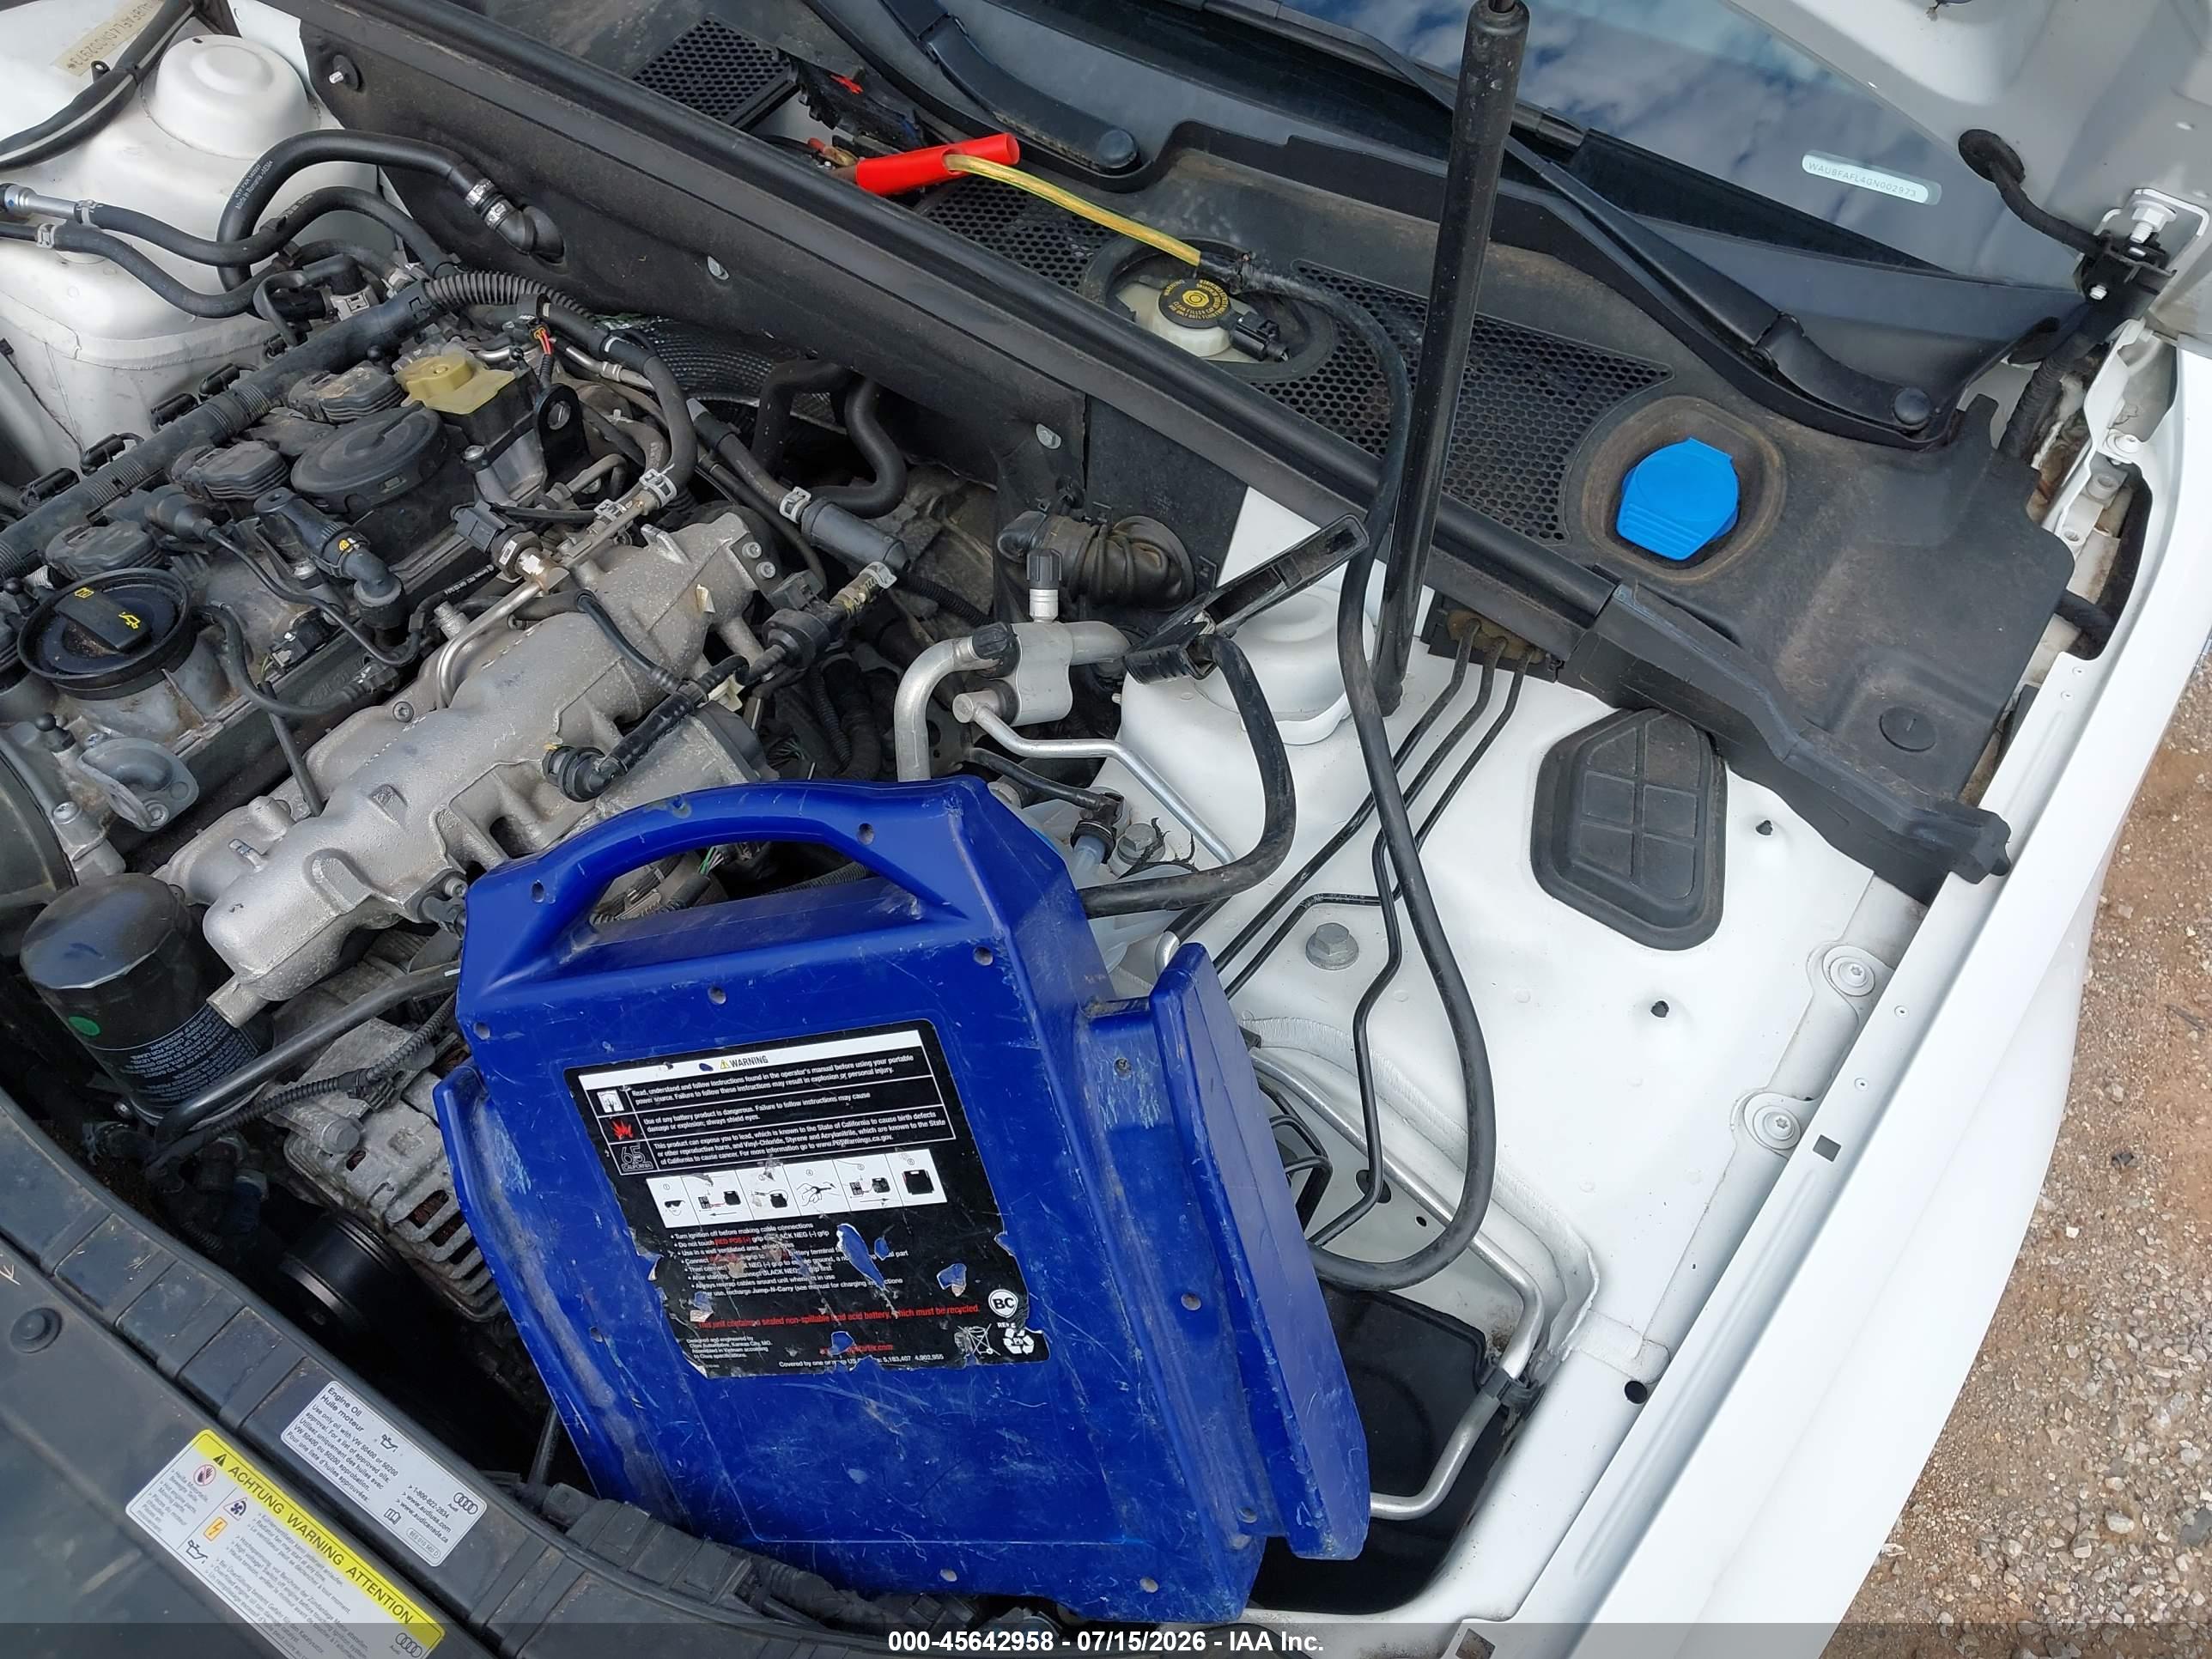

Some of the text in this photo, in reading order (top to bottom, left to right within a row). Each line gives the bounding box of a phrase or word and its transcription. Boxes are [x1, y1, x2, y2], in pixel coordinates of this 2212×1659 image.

[630, 1089, 649, 1098] Read,
[647, 1085, 681, 1095] understand
[690, 1080, 711, 1089] follow
[708, 1076, 744, 1087] instructions
[742, 1073, 763, 1083] found
[810, 1064, 834, 1074] manual
[833, 1061, 854, 1071] before
[854, 1059, 873, 1069] using
[872, 1059, 889, 1067] your
[886, 1054, 915, 1065] portable
[728, 1054, 769, 1068] WARNING
[635, 1097, 653, 1106] power
[673, 1091, 695, 1100] Failure
[700, 1088, 720, 1097] follow
[719, 1085, 738, 1094] these
[735, 1081, 772, 1091] instructions
[784, 1077, 804, 1086] result
[809, 1073, 840, 1084] explosion
[846, 1067, 875, 1079] personal
[873, 1065, 895, 1076] injury.
[646, 1124, 671, 1133] damage
[704, 1117, 727, 1127] always
[725, 1115, 744, 1123] shield
[744, 1114, 761, 1122] eyes.
[672, 1113, 695, 1123] battery
[692, 1109, 717, 1121] product
[754, 1103, 776, 1111] Failure
[782, 1099, 802, 1108] follow
[801, 1095, 838, 1106] instructions
[665, 1139, 690, 1150] product
[699, 1137, 721, 1146] expose
[738, 1132, 755, 1141] lead,
[752, 1129, 771, 1138] which
[777, 1127, 799, 1135] known
[816, 1122, 834, 1131] State
[840, 1118, 871, 1128] California
[896, 1113, 913, 1121] birth
[911, 1110, 937, 1120] defects
[665, 1155, 695, 1164] California
[764, 1144, 799, 1153] information
[992, 1297, 1017, 1310] BC
[319, 1394, 365, 1432] Huile moteur
[325, 1386, 363, 1417] Engine Oil
[310, 1403, 324, 1415] Use
[320, 1412, 335, 1425] only
[331, 1420, 342, 1430] oil
[338, 1426, 354, 1440] with
[226, 1462, 415, 1625] ACHTUNG WARNING ATTENTION
